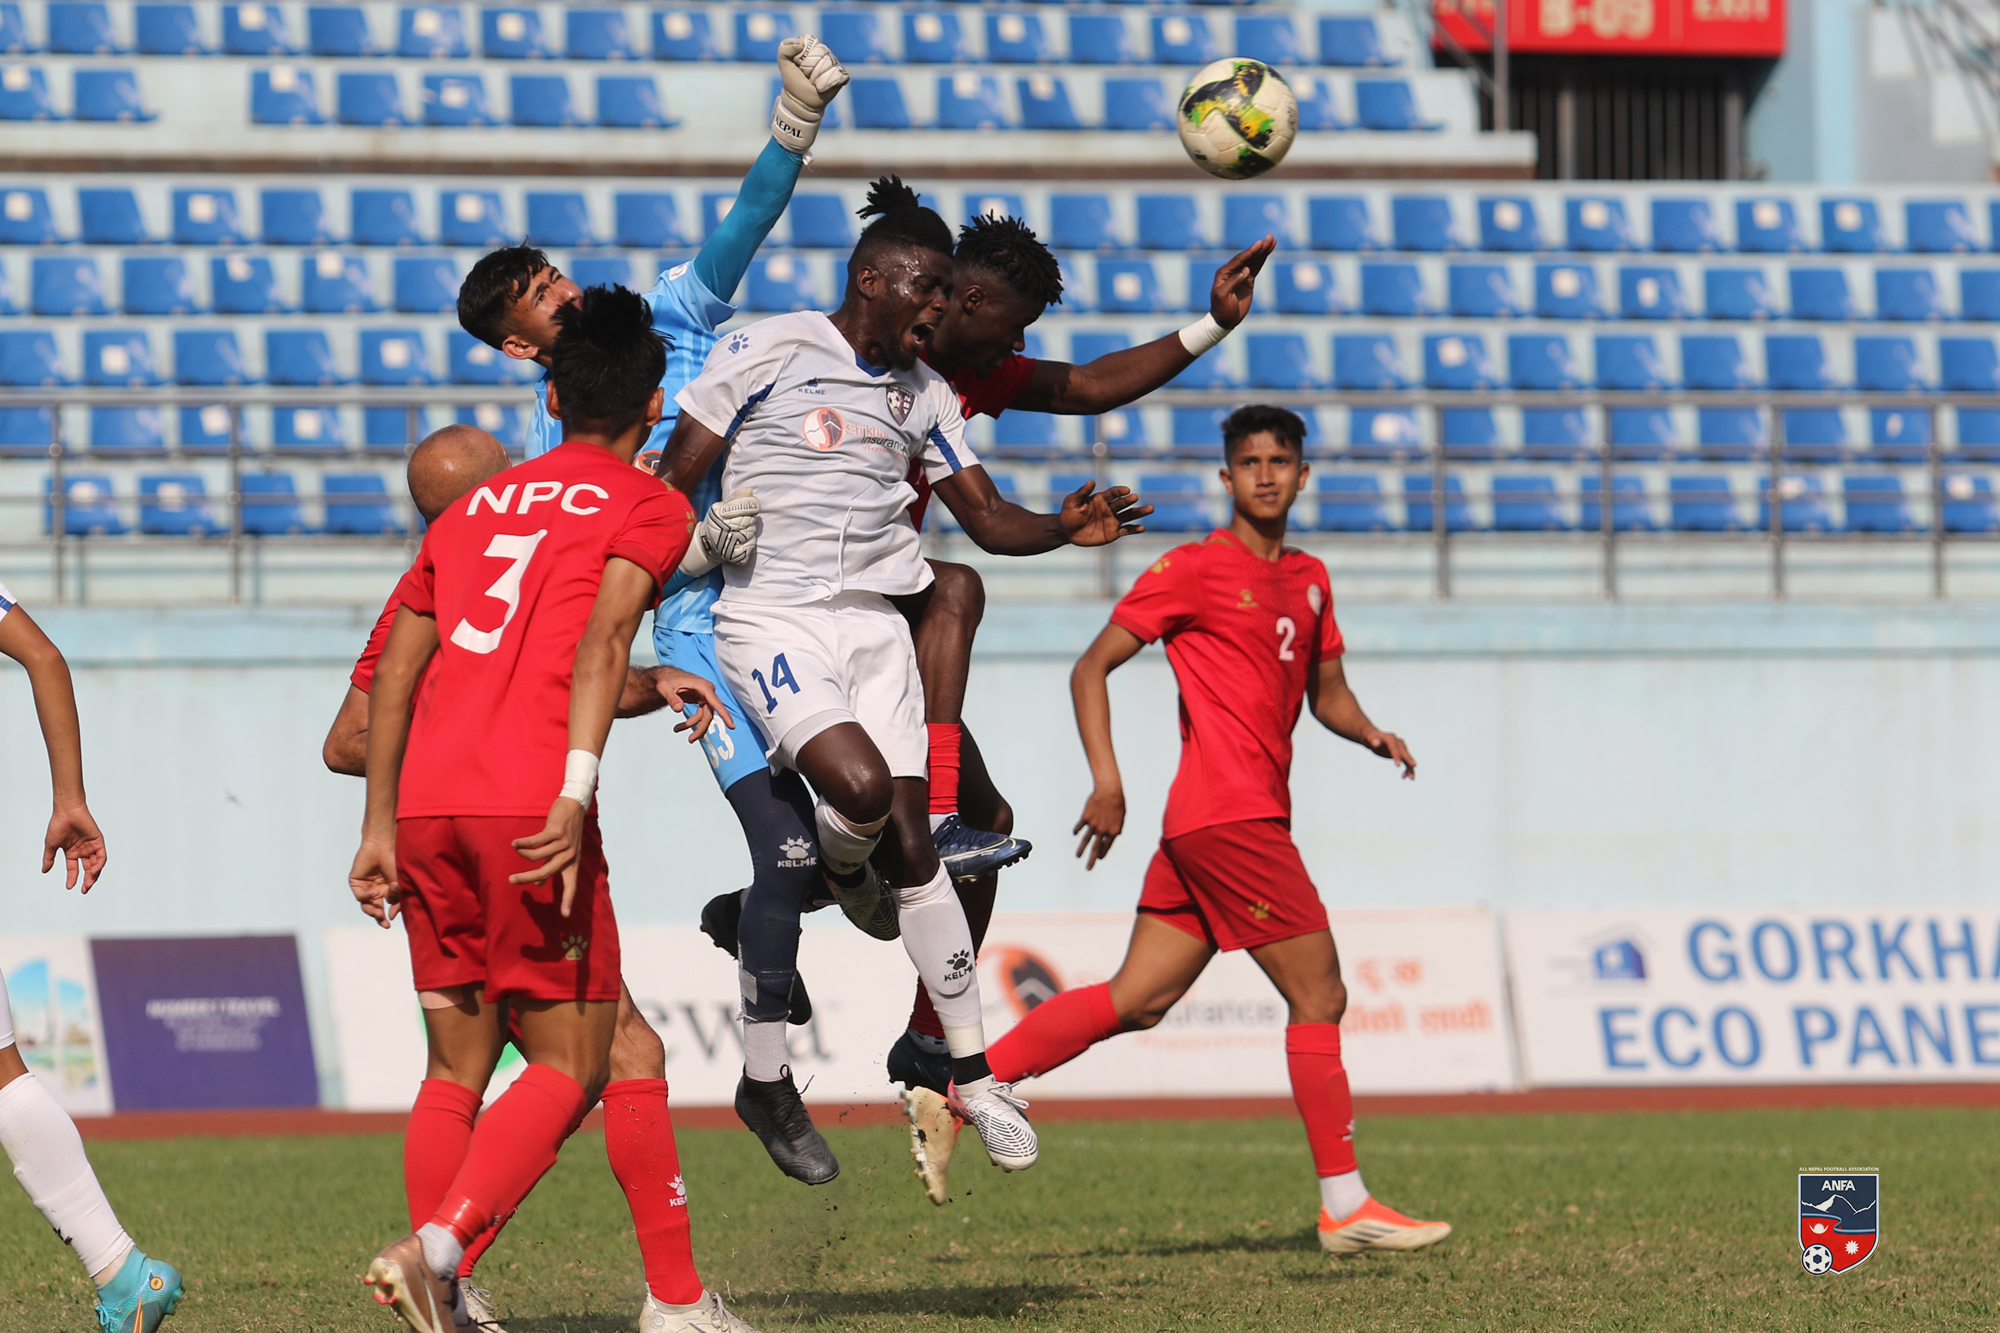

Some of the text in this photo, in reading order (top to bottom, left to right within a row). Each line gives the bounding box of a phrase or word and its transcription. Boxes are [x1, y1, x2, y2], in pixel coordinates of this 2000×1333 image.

[1538, 0, 1655, 39] B-09
[775, 114, 804, 139] NEPAL
[466, 481, 610, 516] NPC
[450, 529, 549, 654] 3
[1276, 616, 1296, 661] 2
[751, 652, 801, 715] 14
[777, 857, 817, 868] KELME
[944, 963, 973, 982] KELM
[1599, 1004, 2000, 1070] ECO PANE
